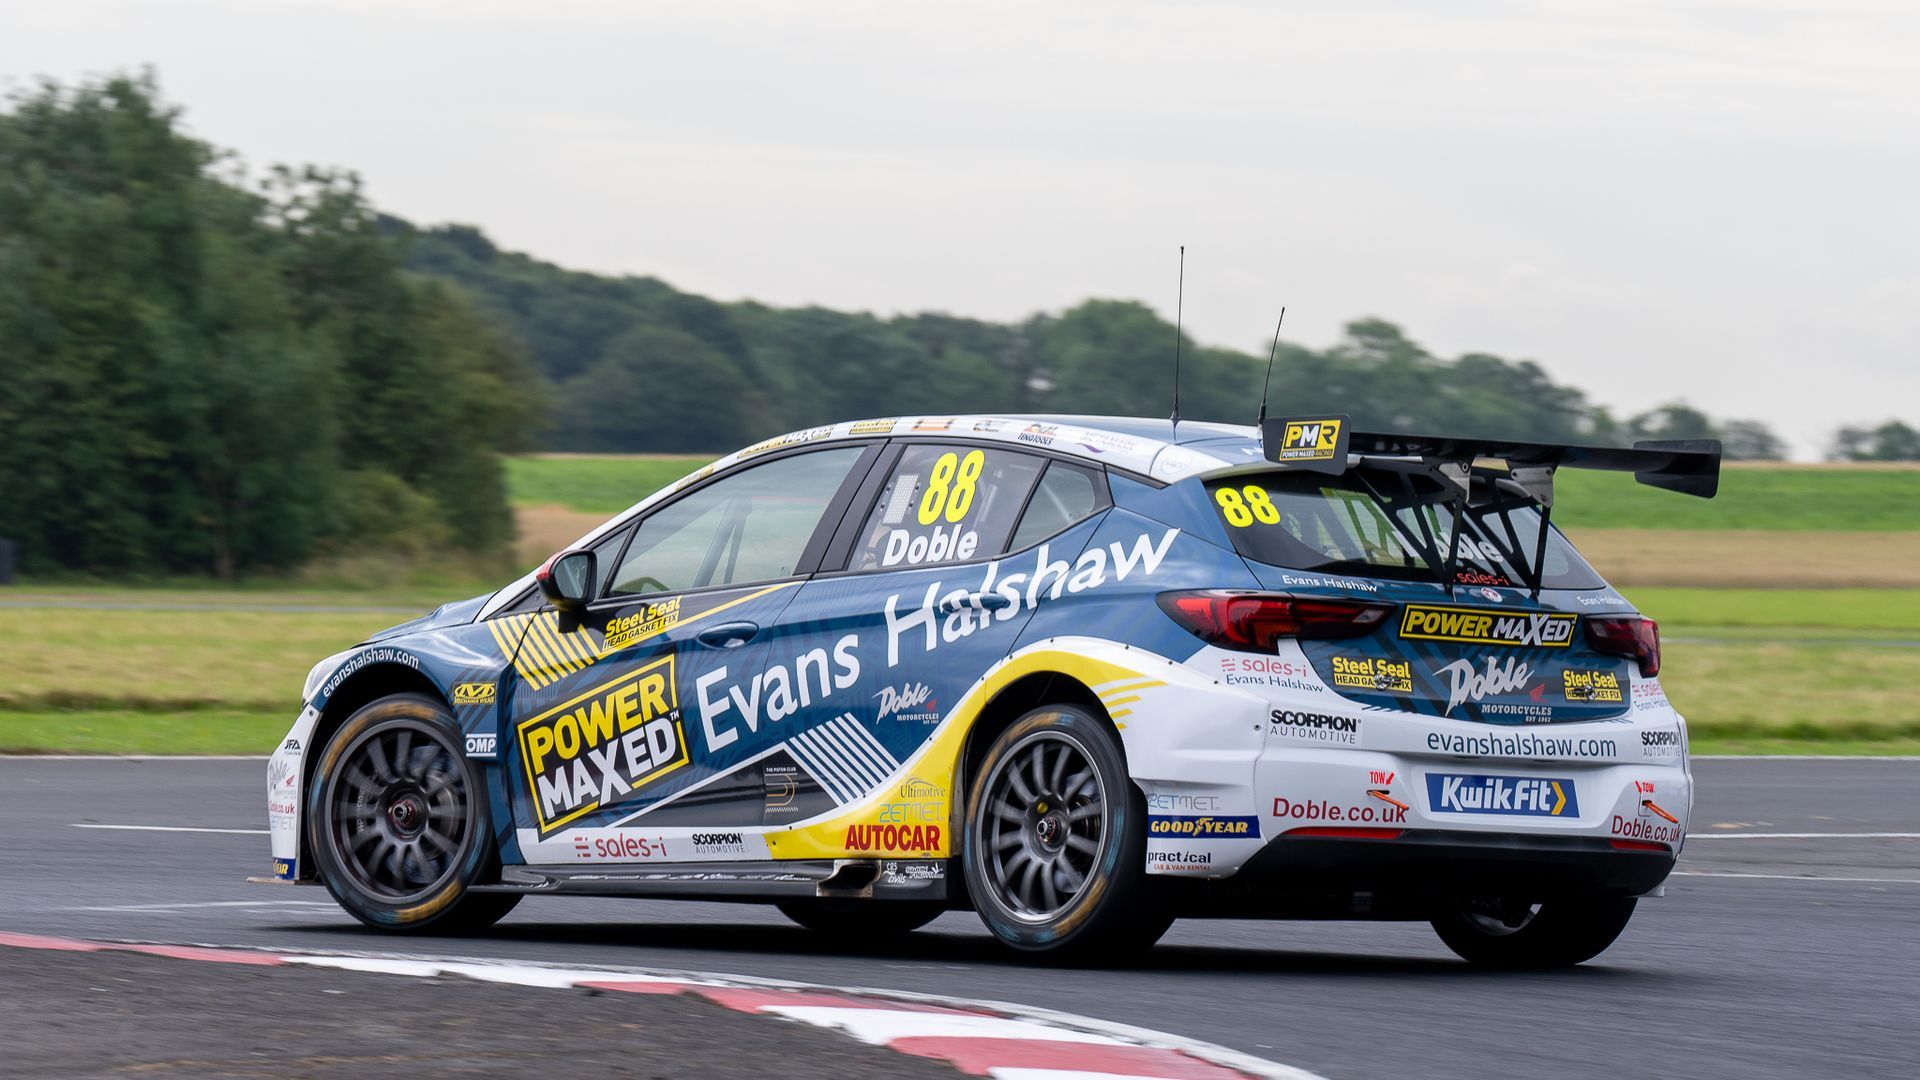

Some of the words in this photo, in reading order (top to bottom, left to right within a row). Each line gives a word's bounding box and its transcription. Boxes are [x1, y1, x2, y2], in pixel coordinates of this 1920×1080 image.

[1285, 424, 1336, 447] PMR
[918, 450, 985, 526] 88
[1215, 484, 1281, 528] 88
[882, 523, 978, 567] Doble
[1282, 574, 1320, 586] Evans
[1323, 577, 1378, 593] Halshaw
[1456, 571, 1510, 586] sales-i
[605, 607, 645, 638] Steel
[647, 594, 683, 620] Seal
[1405, 610, 1492, 637] POWER
[1492, 613, 1572, 646] MAXED
[604, 633, 629, 649] HEAD
[628, 617, 667, 640] GASKET
[665, 611, 678, 626] FIX
[696, 633, 860, 754] Evans
[884, 527, 1180, 668] Halshaw
[323, 646, 419, 698] evanshalshaw.com
[1241, 656, 1307, 686] sales-i
[1332, 656, 1375, 675] Steel
[1376, 659, 1411, 679] Seal
[1335, 674, 1360, 685] HEAD
[1563, 670, 1594, 687] Steel
[1593, 671, 1619, 688] Seal
[1226, 673, 1265, 686] Evans
[1269, 675, 1324, 693] Halshaw
[1433, 655, 1535, 717] Doble
[872, 682, 933, 725] Doble
[1481, 703, 1553, 716] MOTORCYCLES
[527, 672, 669, 776] POWER
[896, 712, 939, 721] MOTORCYCLES
[1270, 709, 1357, 733] SCORPION
[284, 739, 301, 750] JFA
[466, 738, 497, 753] OMP
[1269, 724, 1357, 745] AUTOMOTIVE
[1427, 732, 1617, 758] evanshalshaw.com
[1640, 731, 1680, 746] SCORPION
[537, 716, 677, 820] MAXED
[1370, 772, 1386, 785] TOW
[900, 784, 946, 798] Ultimotive
[1642, 781, 1655, 793] TOW
[1272, 797, 1408, 823] Doble.co.uk
[692, 832, 743, 846] SCORPION
[845, 824, 941, 851] AUTOCAR
[1611, 815, 1682, 842] Doble.co.uk
[595, 833, 667, 858] sales-i
[695, 844, 746, 854] AUTOMOTIVE
